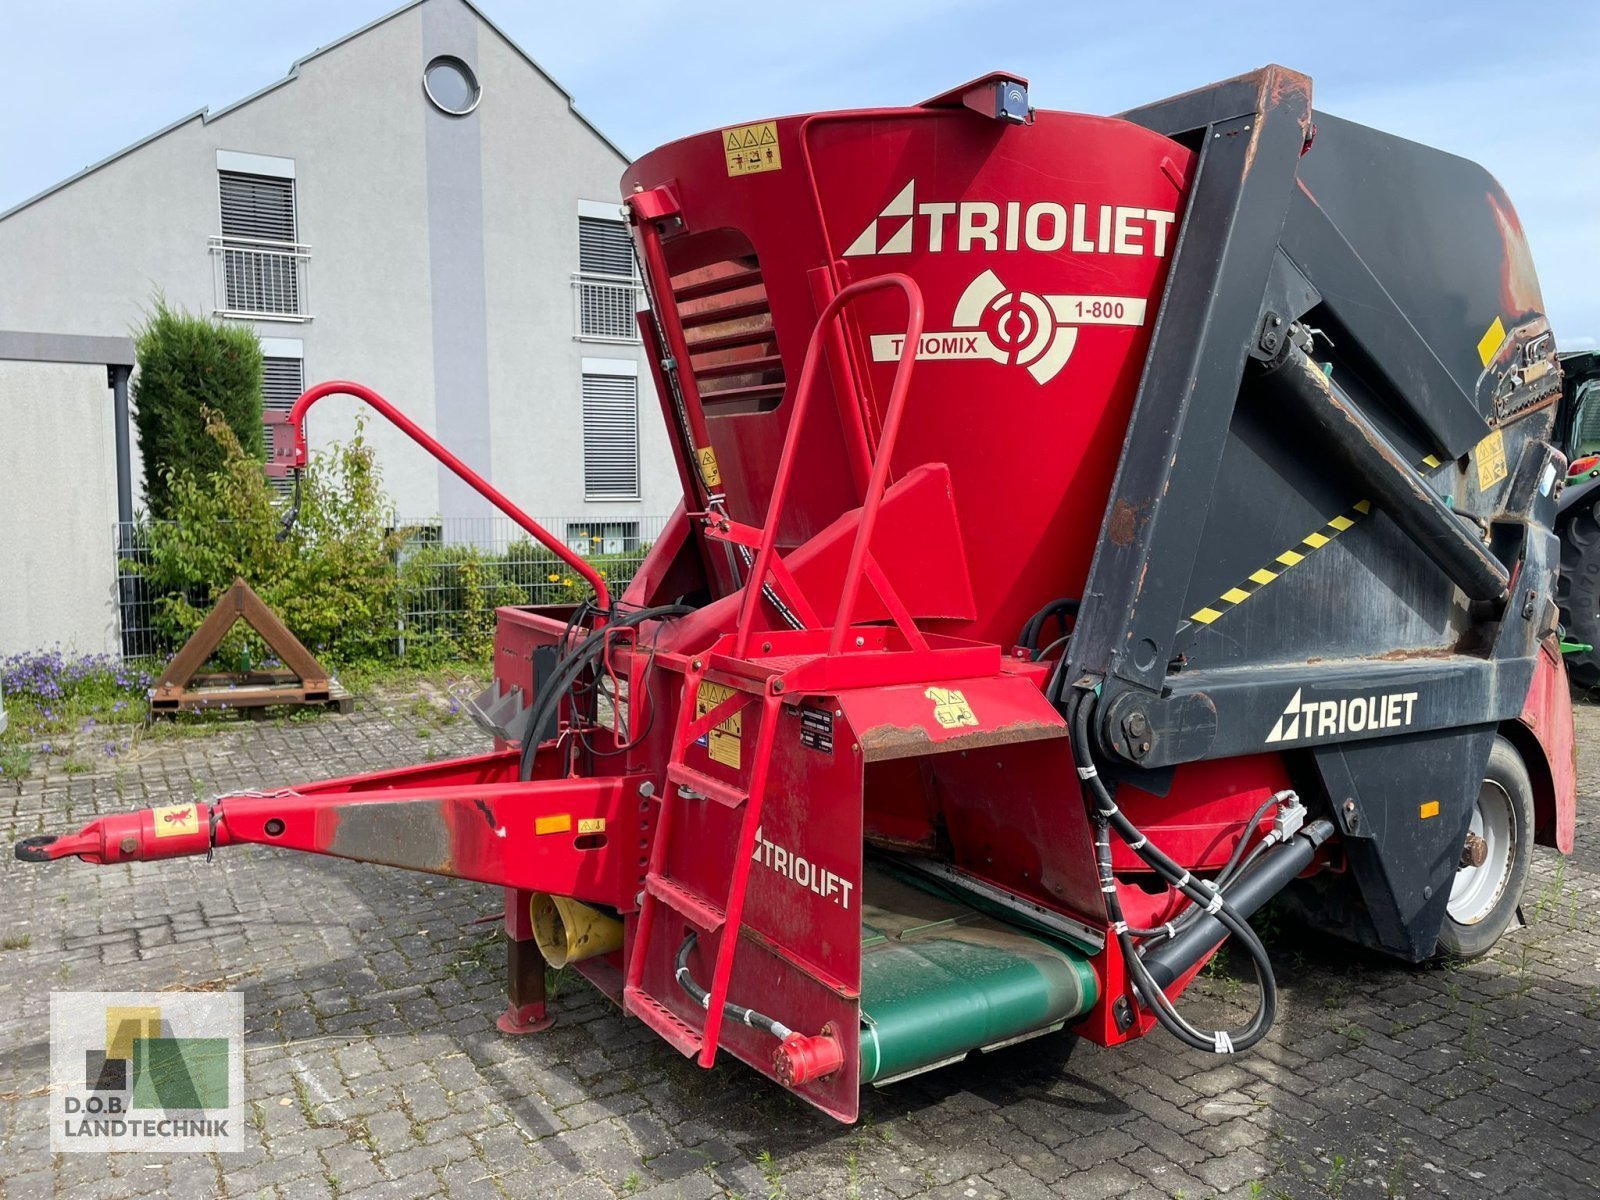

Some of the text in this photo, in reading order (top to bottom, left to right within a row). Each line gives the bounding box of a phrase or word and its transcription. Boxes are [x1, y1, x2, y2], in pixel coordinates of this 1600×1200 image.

[919, 201, 1176, 257] TRIOLIET
[1074, 301, 1125, 319] 1-800
[891, 336, 978, 356] TIOMIX
[1301, 692, 1418, 738] TRIOLIET
